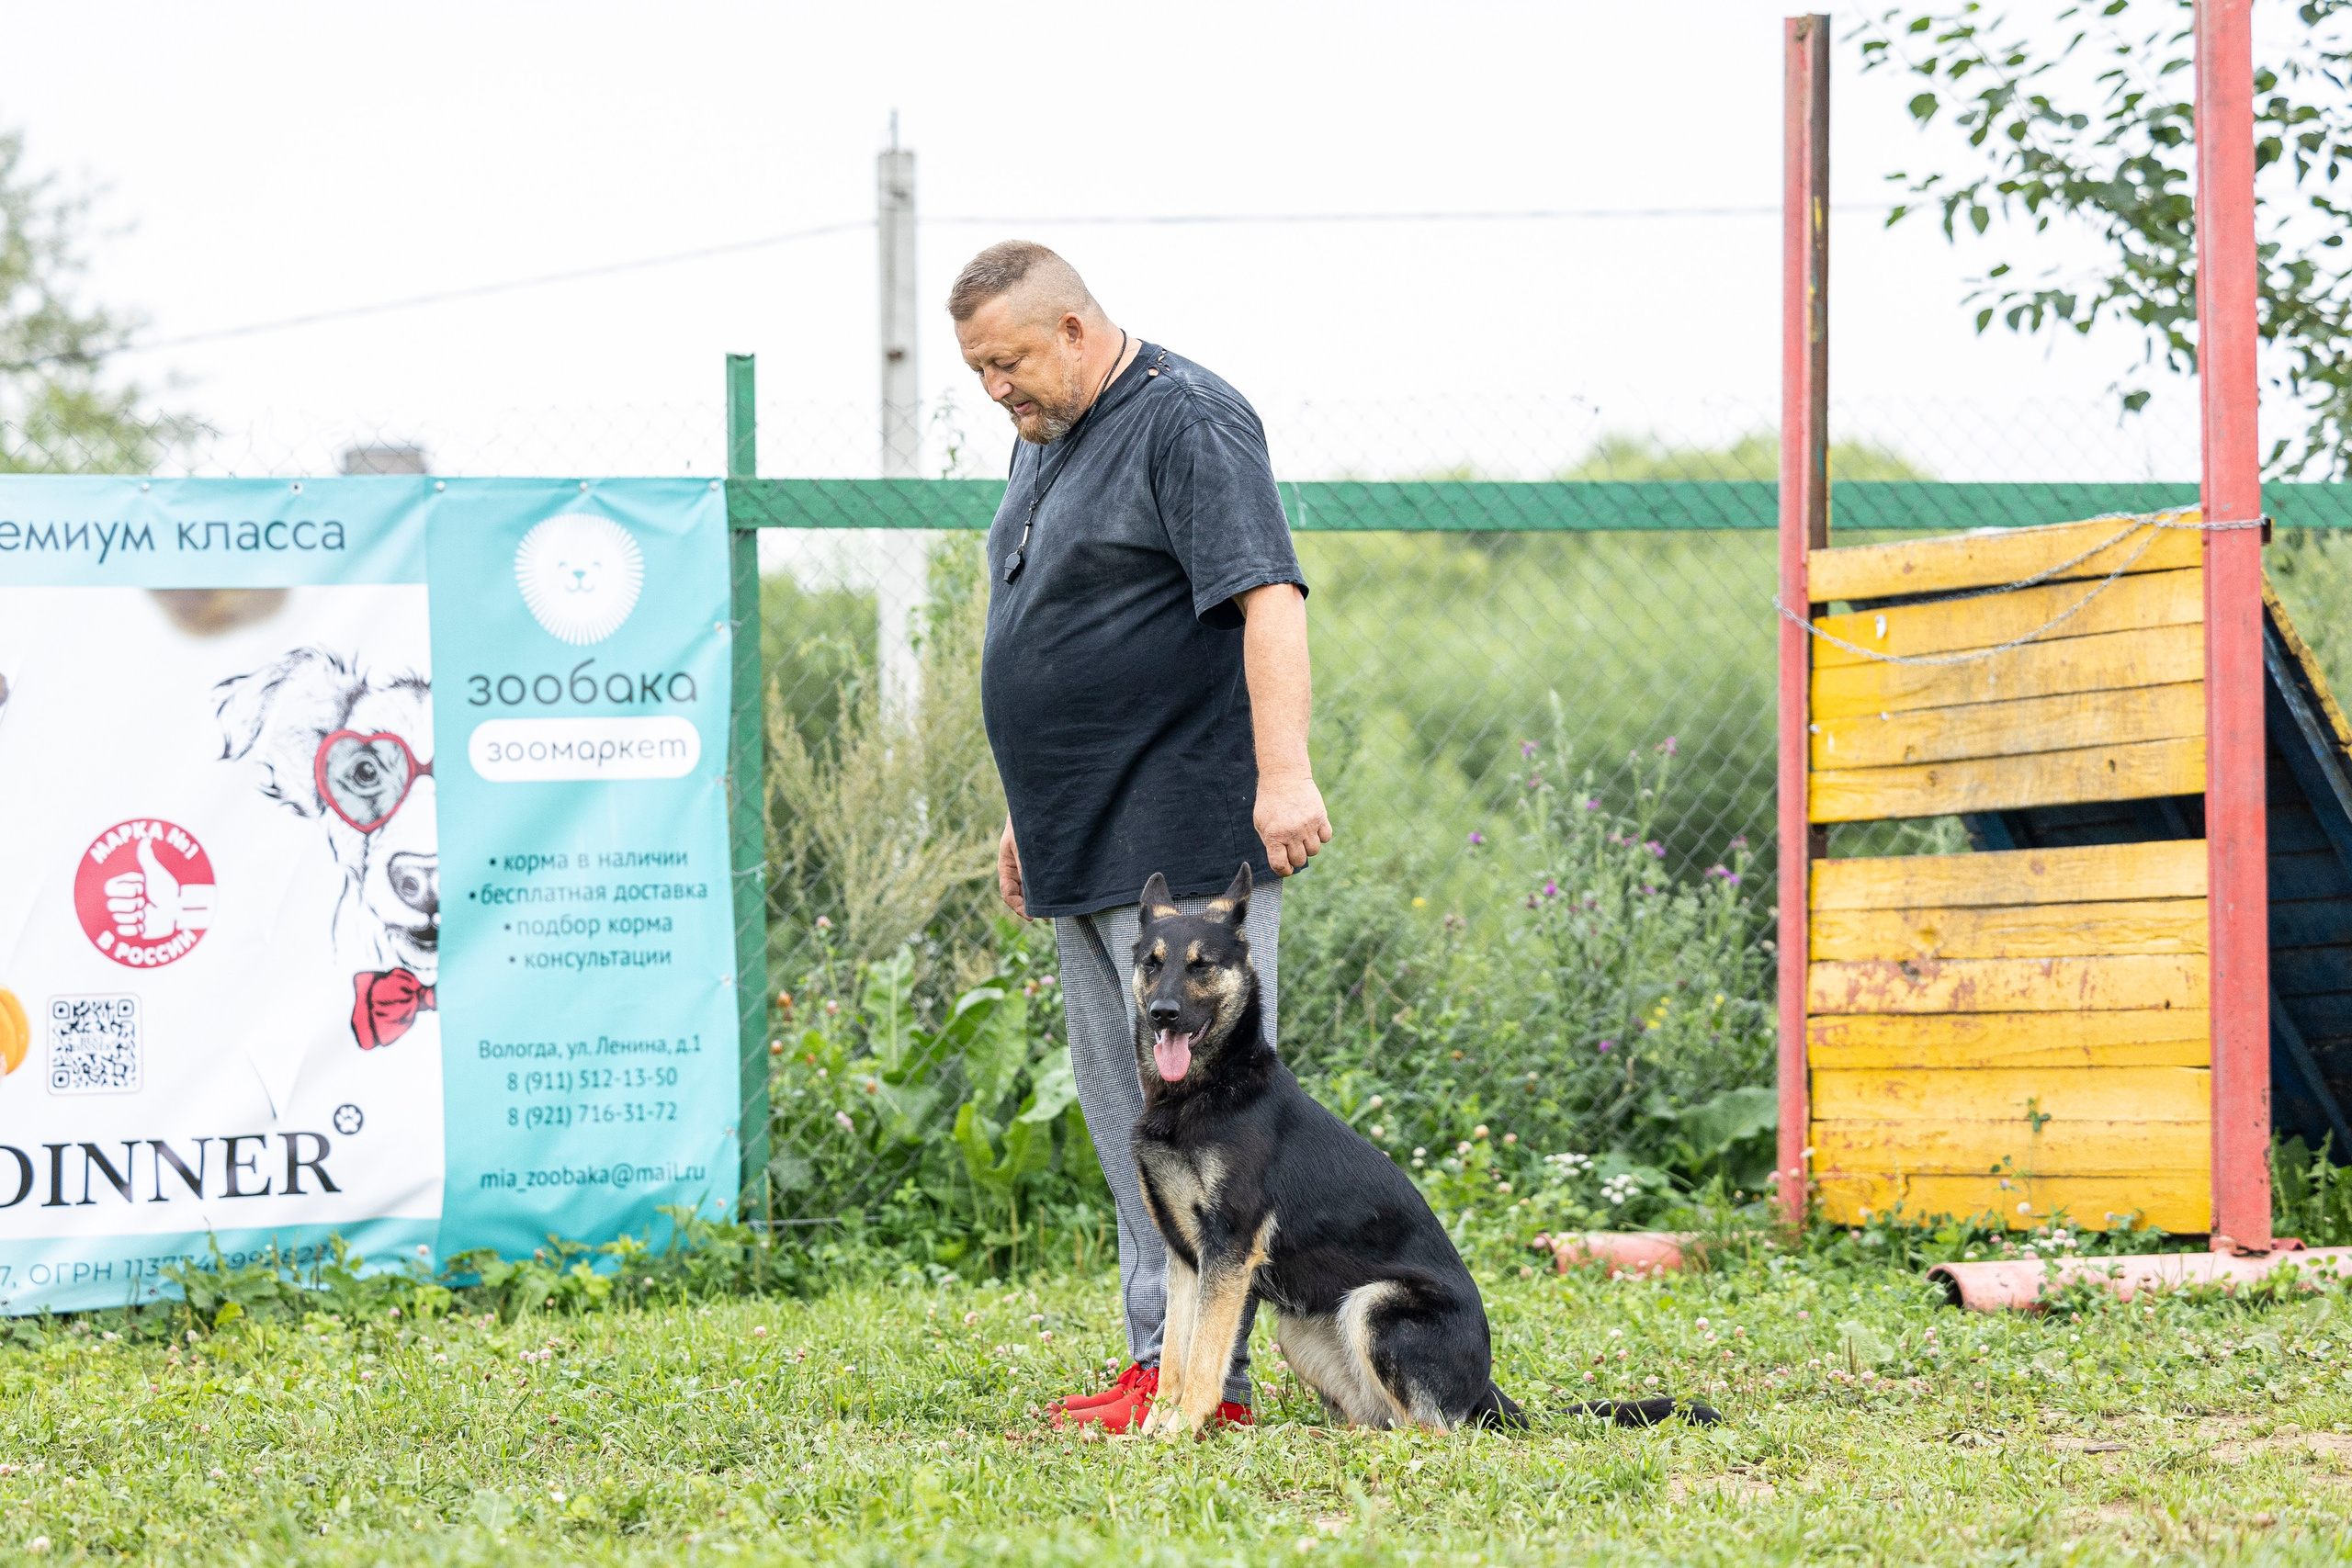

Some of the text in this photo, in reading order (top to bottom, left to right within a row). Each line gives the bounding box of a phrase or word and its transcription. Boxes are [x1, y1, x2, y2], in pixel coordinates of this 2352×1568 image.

[177, 519, 345, 551] класса
[467, 657, 697, 705] зообака
[486, 739, 687, 767] зоомаркет
[89, 820, 199, 864] МАРКА №1
[503, 850, 689, 875] корма в наличии
[481, 882, 708, 905] бесплатная доставка
[517, 914, 673, 938] подбор корма
[96, 930, 198, 965] В РОССИИ
[524, 949, 673, 973] консультации
[479, 1040, 562, 1060] Вологда,
[567, 1041, 591, 1061] ул.
[596, 1036, 672, 1057] Ленина,
[507, 1066, 679, 1095] 8 (911) 512-13-50
[507, 1101, 677, 1130] 8 (921) 716-31-72
[480, 1162, 707, 1193] mia_zoobaka@mail.ru
[29, 1260, 113, 1285] ОГРН
